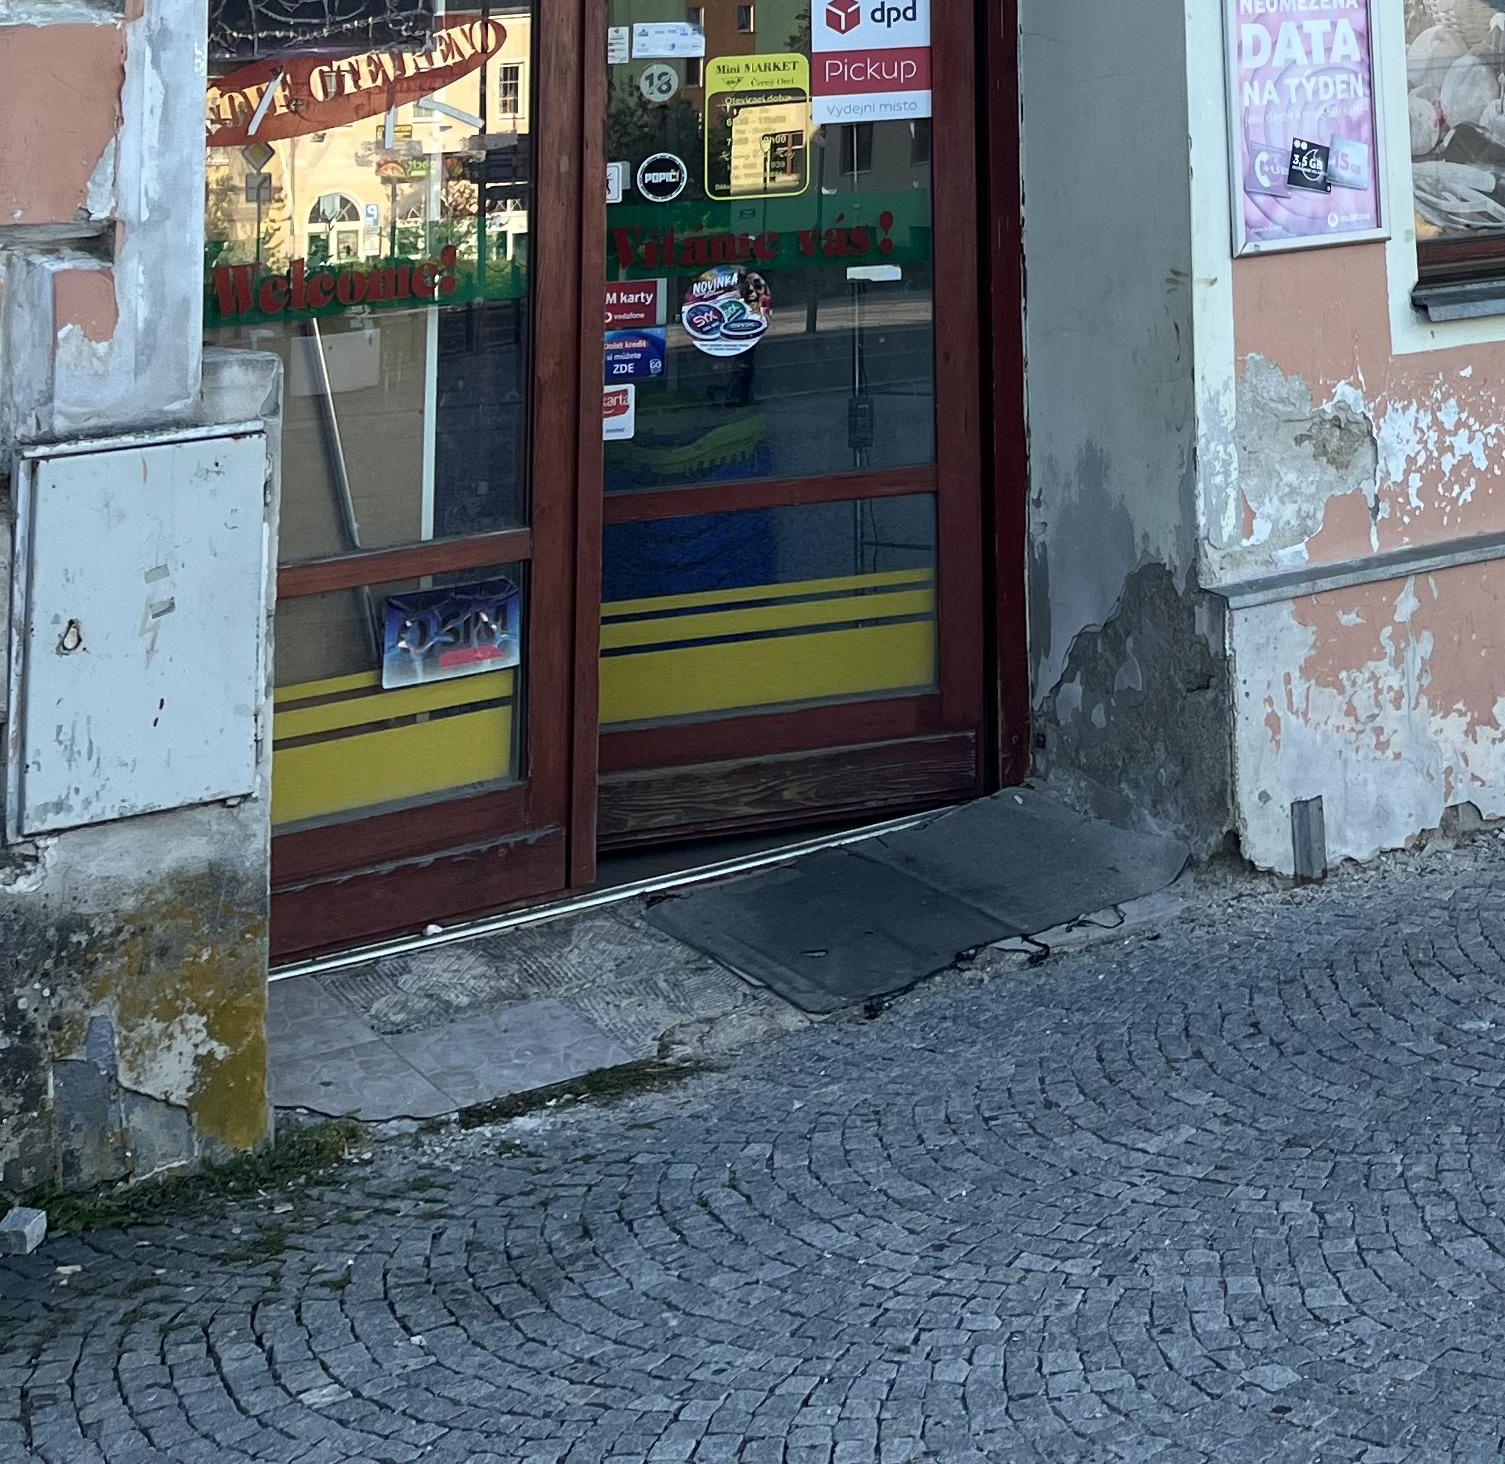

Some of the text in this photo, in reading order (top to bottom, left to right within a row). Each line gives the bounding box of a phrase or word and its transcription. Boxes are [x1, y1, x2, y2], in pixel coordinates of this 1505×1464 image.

[870, 0, 917, 28] dpd
[1240, 17, 1361, 70] DATA
[715, 60, 799, 75] Mini MARKET
[825, 57, 917, 84] Pickup
[1243, 68, 1365, 107] NA TÝDEN
[827, 100, 918, 117] Výdejní místo
[213, 244, 457, 318] Welcome!
[692, 272, 739, 296] NOVINKA
[620, 291, 654, 306] karty
[613, 312, 645, 320] vodafone
[612, 363, 635, 374] ZDE
